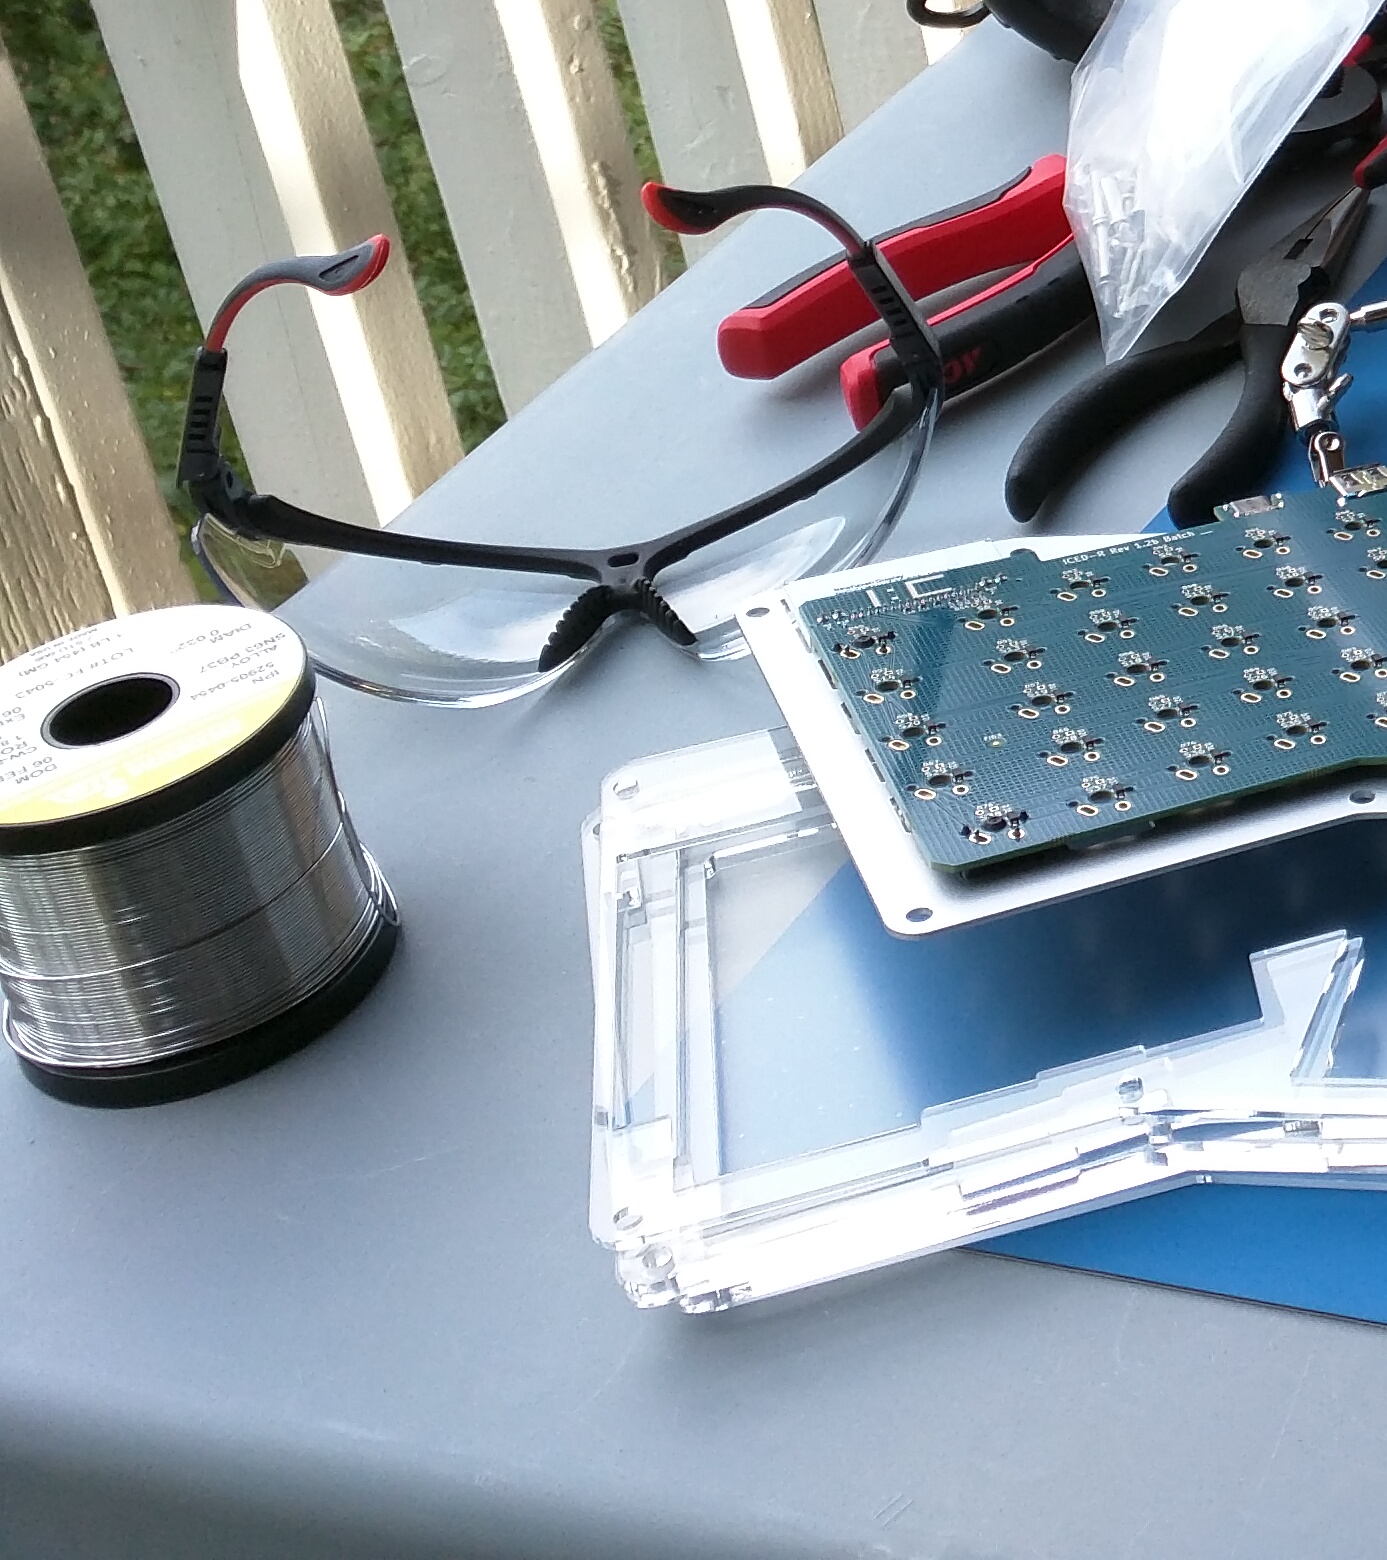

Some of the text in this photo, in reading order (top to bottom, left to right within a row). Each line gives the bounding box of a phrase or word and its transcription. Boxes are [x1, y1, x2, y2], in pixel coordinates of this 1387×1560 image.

[1108, 544, 1131, 556] Rev
[1162, 530, 1196, 544] Batch
[209, 622, 252, 645] DIAM
[230, 643, 279, 669] ALLOY
[251, 669, 281, 685] IPN
[14, 762, 58, 785] DOM
